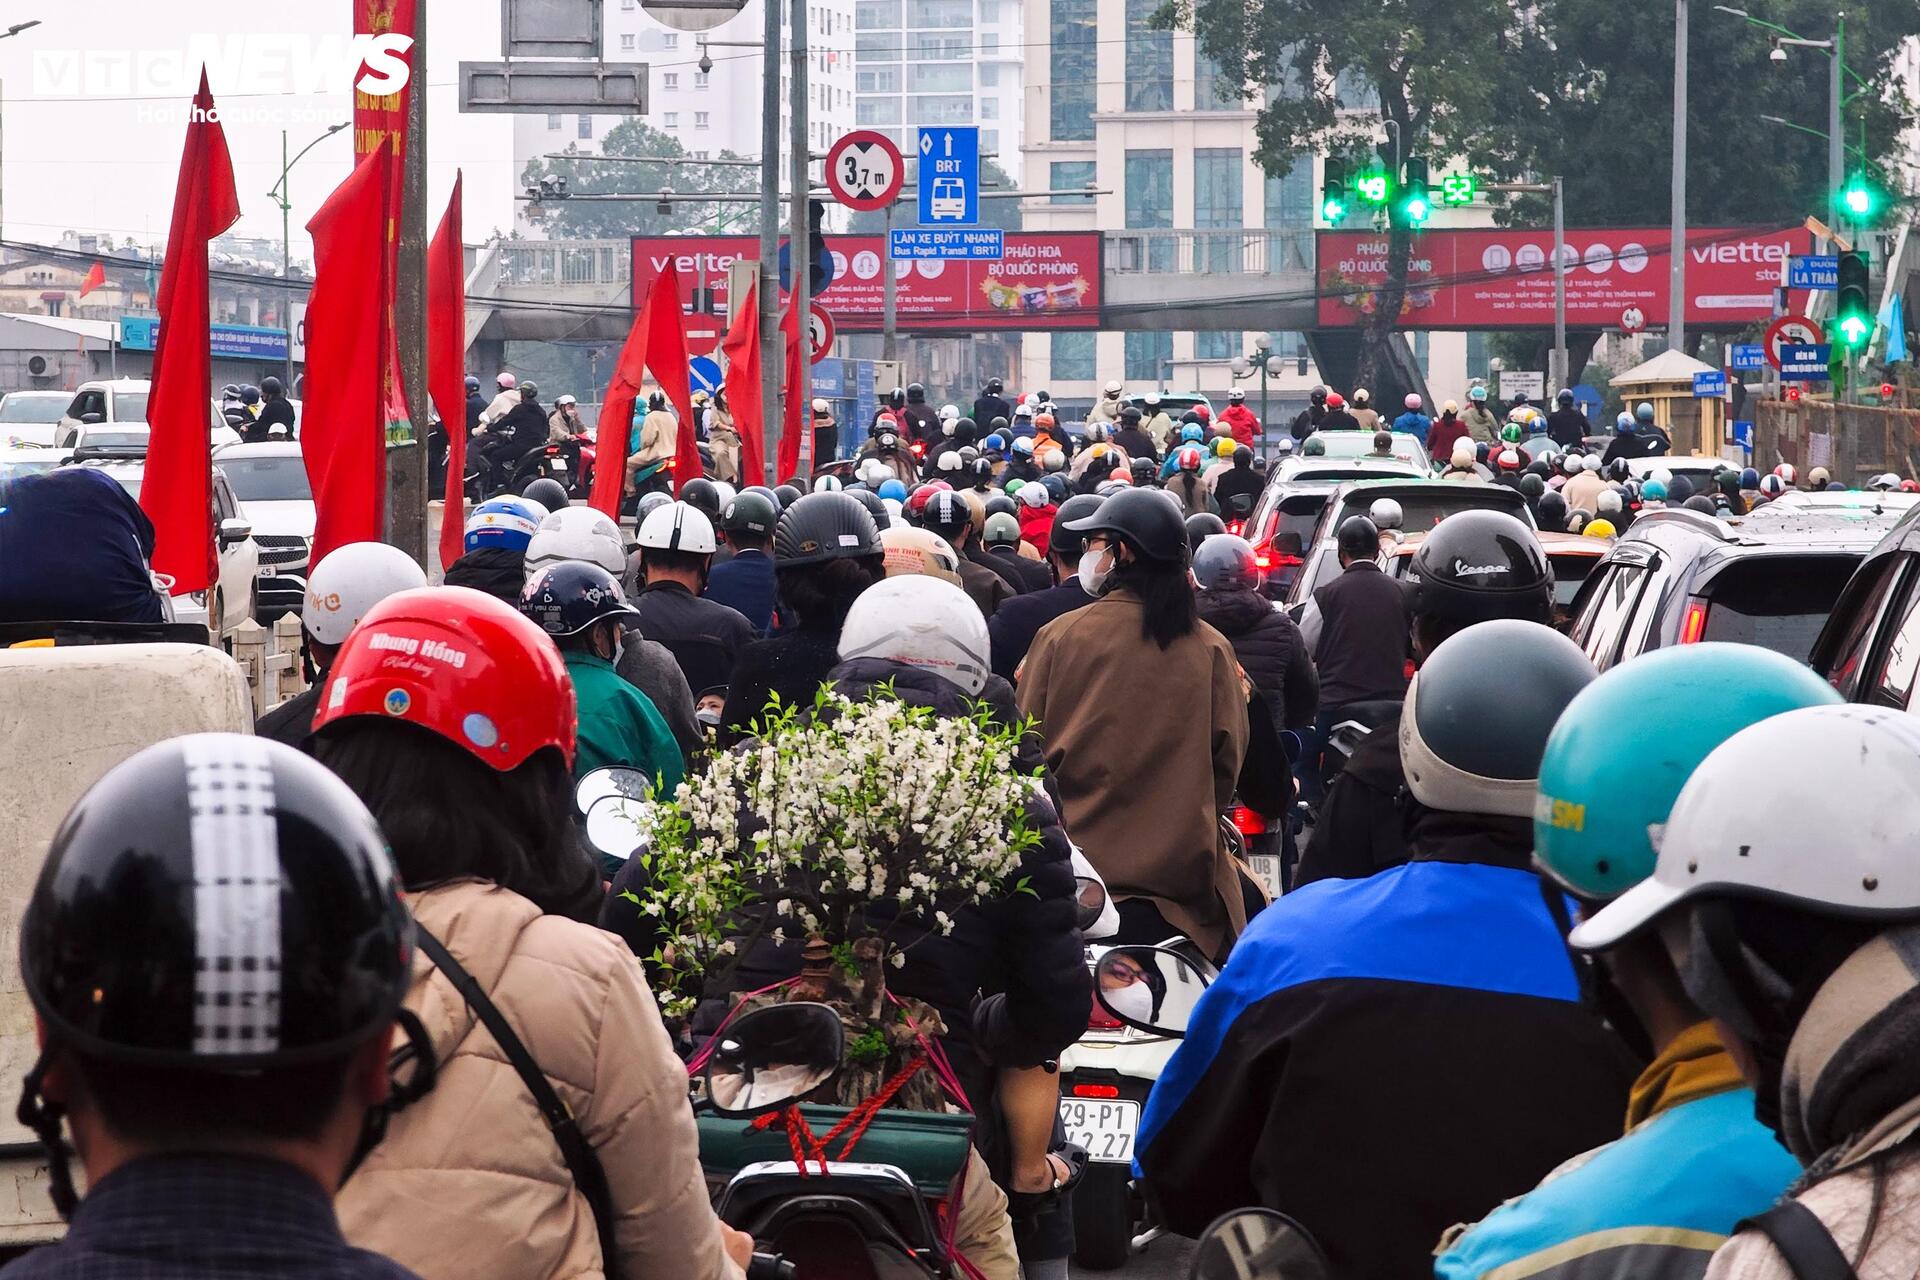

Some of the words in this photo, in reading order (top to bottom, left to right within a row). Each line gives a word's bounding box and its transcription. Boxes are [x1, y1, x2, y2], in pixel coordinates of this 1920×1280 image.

[936, 160, 961, 173] BRT
[1357, 177, 1387, 201] 49
[1445, 178, 1472, 203] 52
[894, 231, 915, 243] LÀN
[919, 233, 930, 243] XE
[934, 230, 960, 243] BUÝT
[964, 233, 999, 243] NHANH
[894, 246, 909, 255] Bus
[914, 246, 936, 258] Rapid
[940, 246, 967, 256] Transit
[973, 246, 999, 257] (BRT)
[1005, 243, 1036, 257] PHÁO
[1038, 246, 1061, 257] HOA
[1691, 241, 1790, 263] viettel
[650, 251, 743, 273] vettel
[989, 261, 1004, 277] BỘ
[1006, 260, 1037, 275] QUỐC
[1039, 260, 1078, 275] PHÒNG
[1407, 257, 1432, 272] ÒNG
[1810, 258, 1838, 268] ĐƯỜN
[1794, 272, 1809, 284] LA
[1811, 270, 1839, 284] THÀN
[1061, 1102, 1124, 1129] 29-P1
